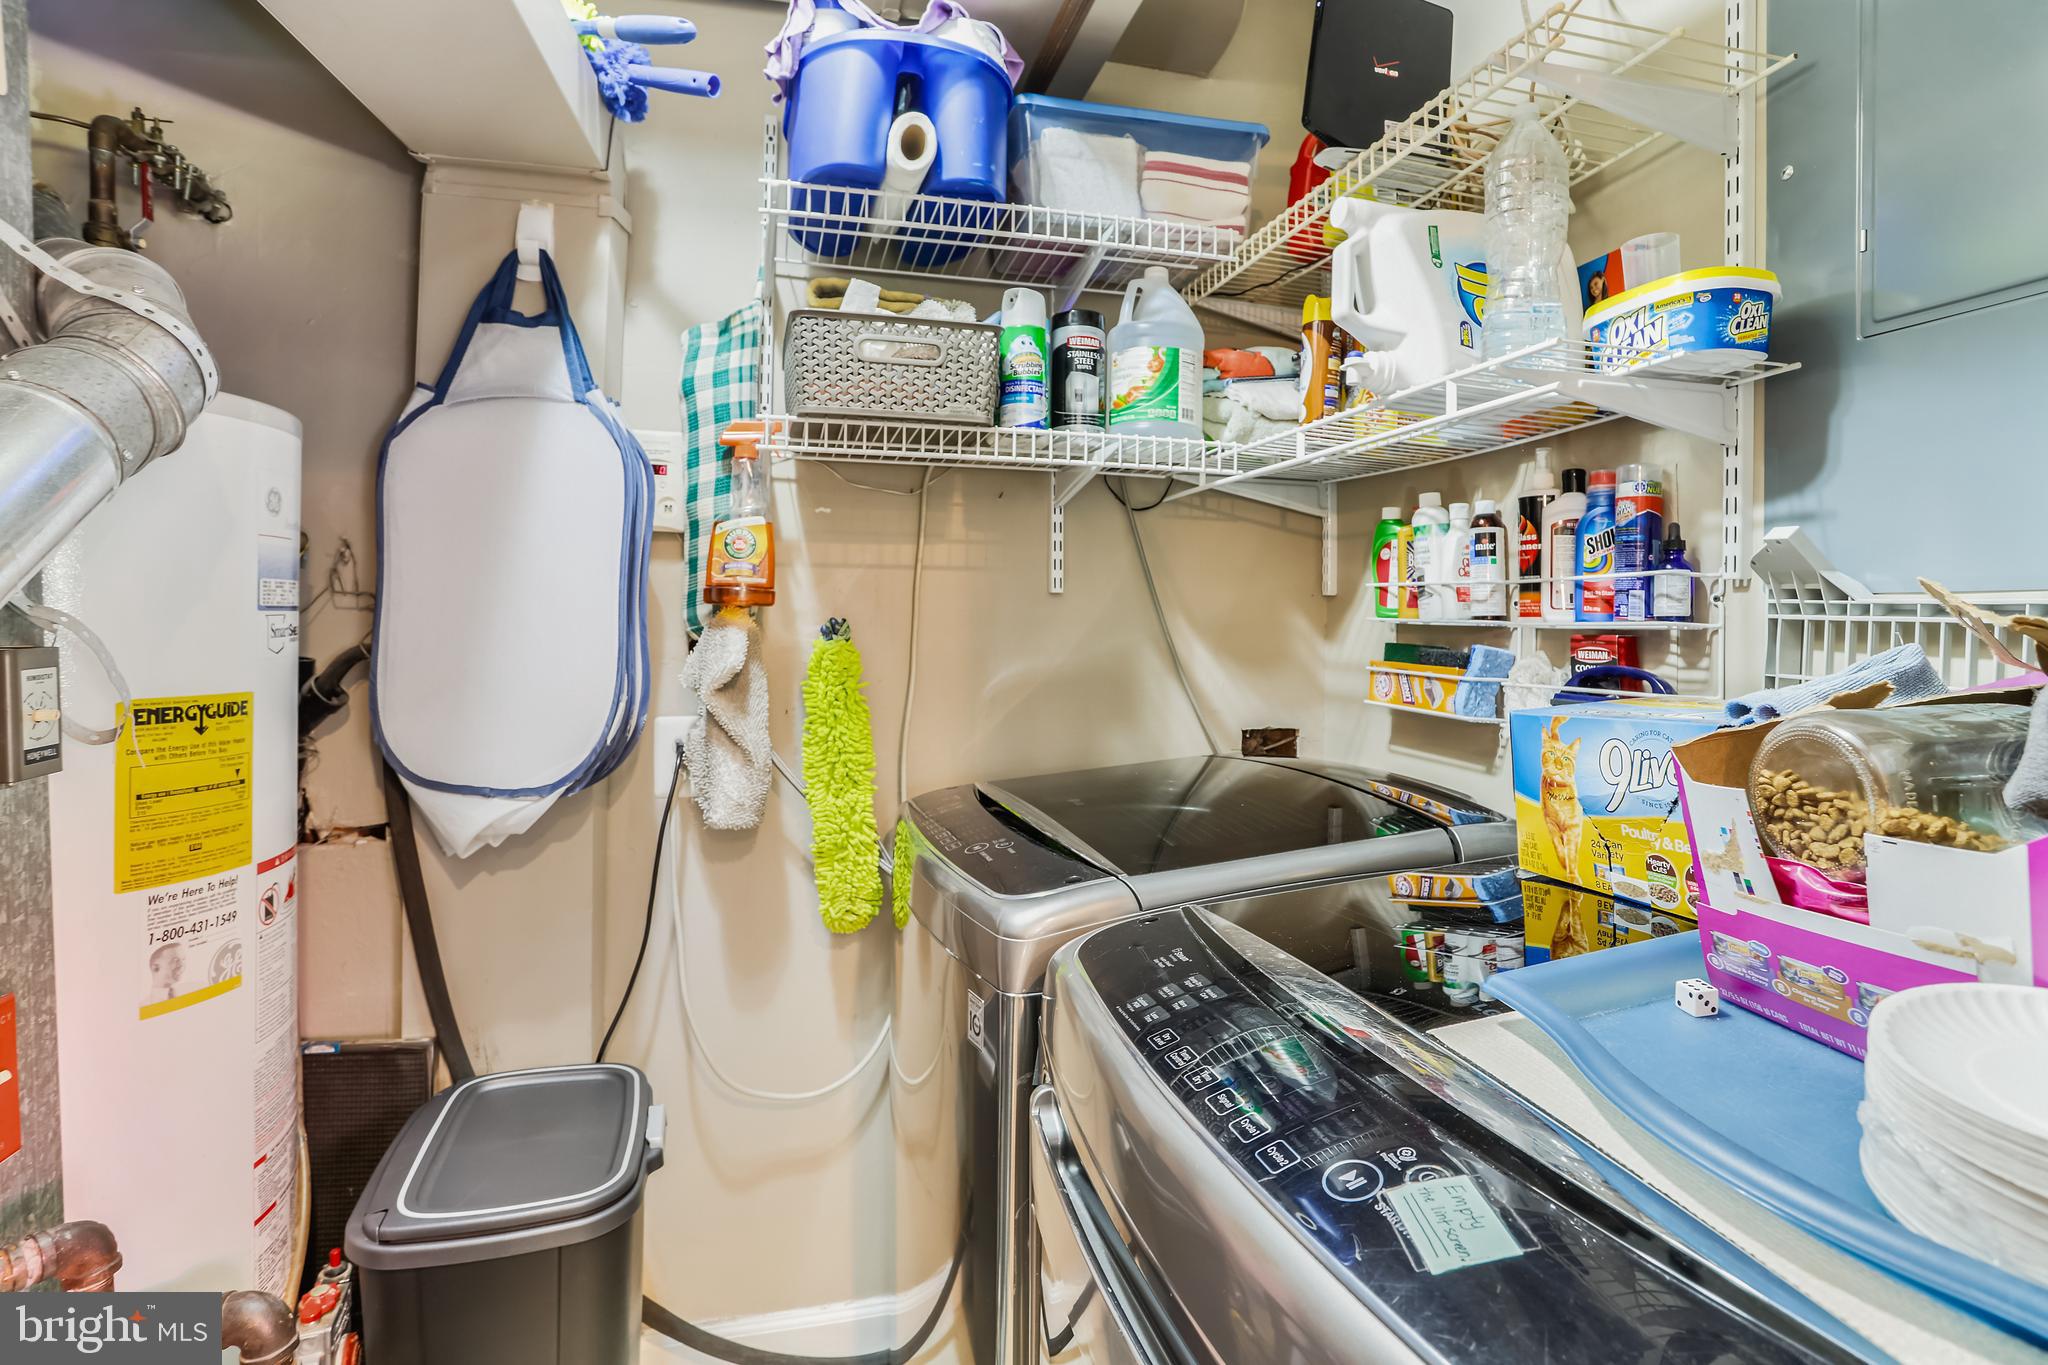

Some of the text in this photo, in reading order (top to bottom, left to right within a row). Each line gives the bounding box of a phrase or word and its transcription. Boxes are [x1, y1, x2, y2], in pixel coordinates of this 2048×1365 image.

[1656, 298, 1686, 310] America's
[1740, 301, 1764, 320] OXI
[1609, 305, 1647, 346] OXI
[1729, 314, 1769, 336] CLEAN
[1069, 337, 1100, 347] WEIMAN
[1067, 350, 1101, 360] STAINLESS
[1073, 358, 1095, 366] STEEL
[1010, 361, 1043, 371] Scrubbing
[1519, 533, 1537, 541] lass
[1578, 651, 1609, 660] WEIMAN
[133, 700, 248, 728] ENERGYGUIDE
[1629, 729, 1674, 747] CARING FOR CAT
[1599, 737, 1679, 813] 9Live
[1641, 798, 1663, 810] SINCE
[1590, 839, 1601, 849] 24
[1662, 838, 1674, 849] &
[1647, 857, 1672, 870] Hearty
[1651, 864, 1668, 875] Cuts
[147, 893, 178, 906] We're
[181, 886, 204, 899] Here
[207, 881, 216, 893] To
[218, 874, 239, 889] Help!
[148, 910, 238, 946] 1-800-431-1549
[1798, 1021, 1821, 1038] TOTAL
[1217, 1093, 1236, 1109] Signal
[1417, 1186, 1435, 1204] the
[1430, 1205, 1451, 1225] lint
[1442, 1184, 1486, 1231] Empty
